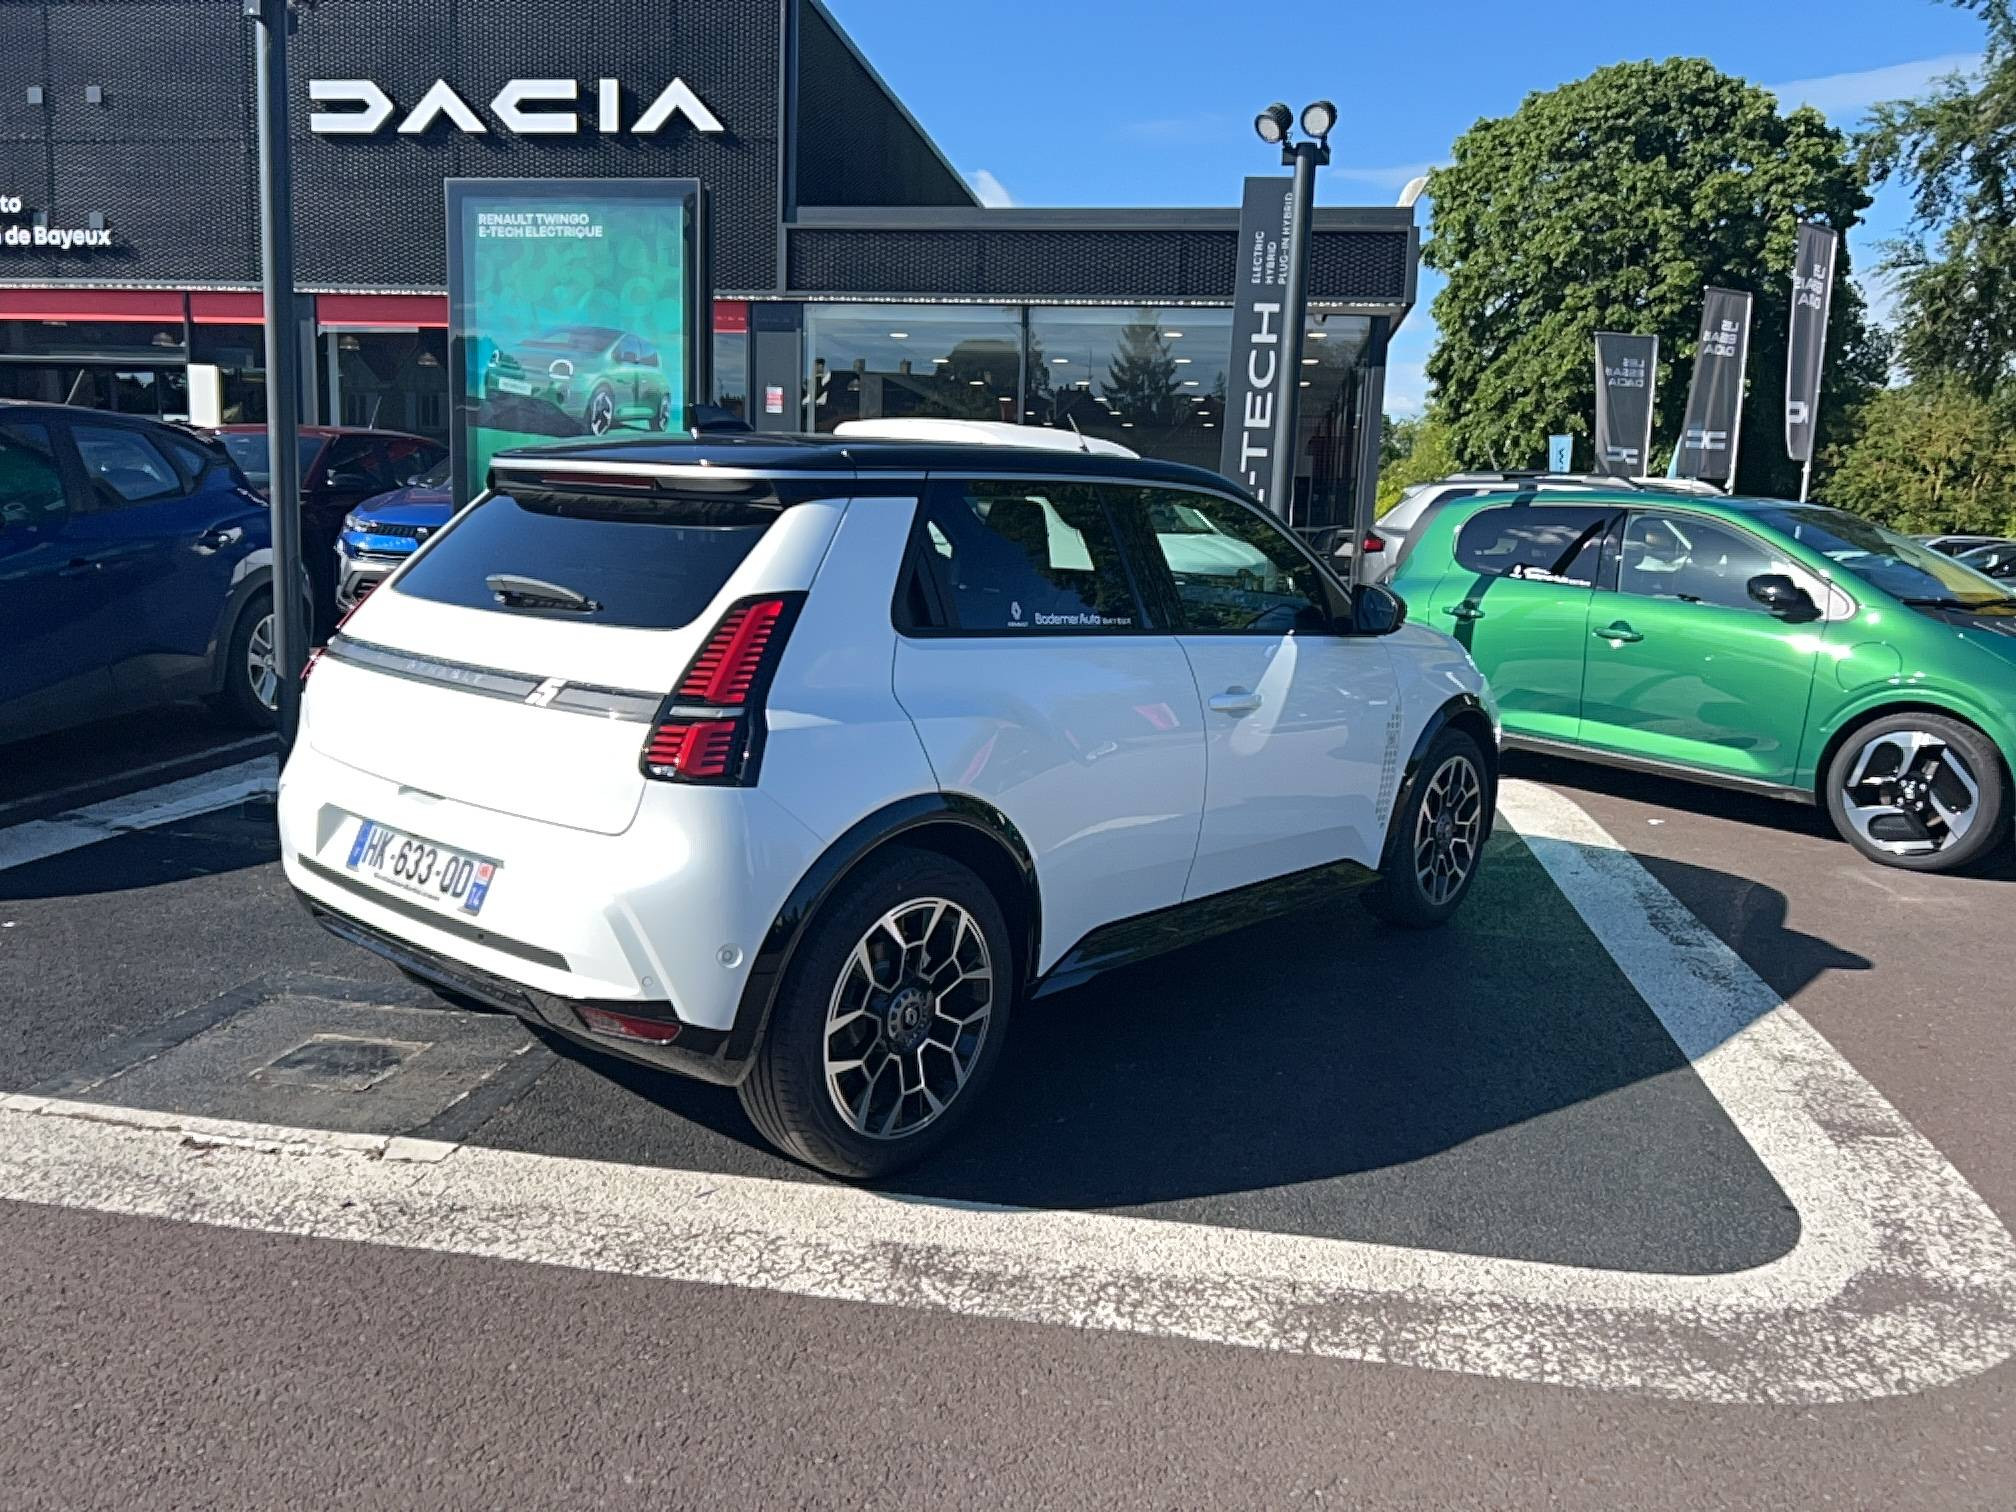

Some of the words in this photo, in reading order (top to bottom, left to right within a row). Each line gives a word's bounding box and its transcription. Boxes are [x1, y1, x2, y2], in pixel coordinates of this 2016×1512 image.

[308, 76, 726, 134] DACIA
[478, 213, 534, 225] RENAULT
[536, 213, 590, 225] TWINGO
[478, 225, 523, 238] E-TECH
[525, 225, 604, 239] ELECTRIQUE
[1282, 192, 1294, 236] HYBRID
[5, 225, 31, 246] de
[33, 225, 112, 250] Bayeux
[1250, 230, 1265, 285] ELECTRIC
[1265, 241, 1277, 286] HYBRID
[1277, 237, 1290, 286] PLUG-IN
[1240, 302, 1281, 504] -TECH
[1034, 612, 1079, 625] Bodemer
[1079, 612, 1101, 625] Auto
